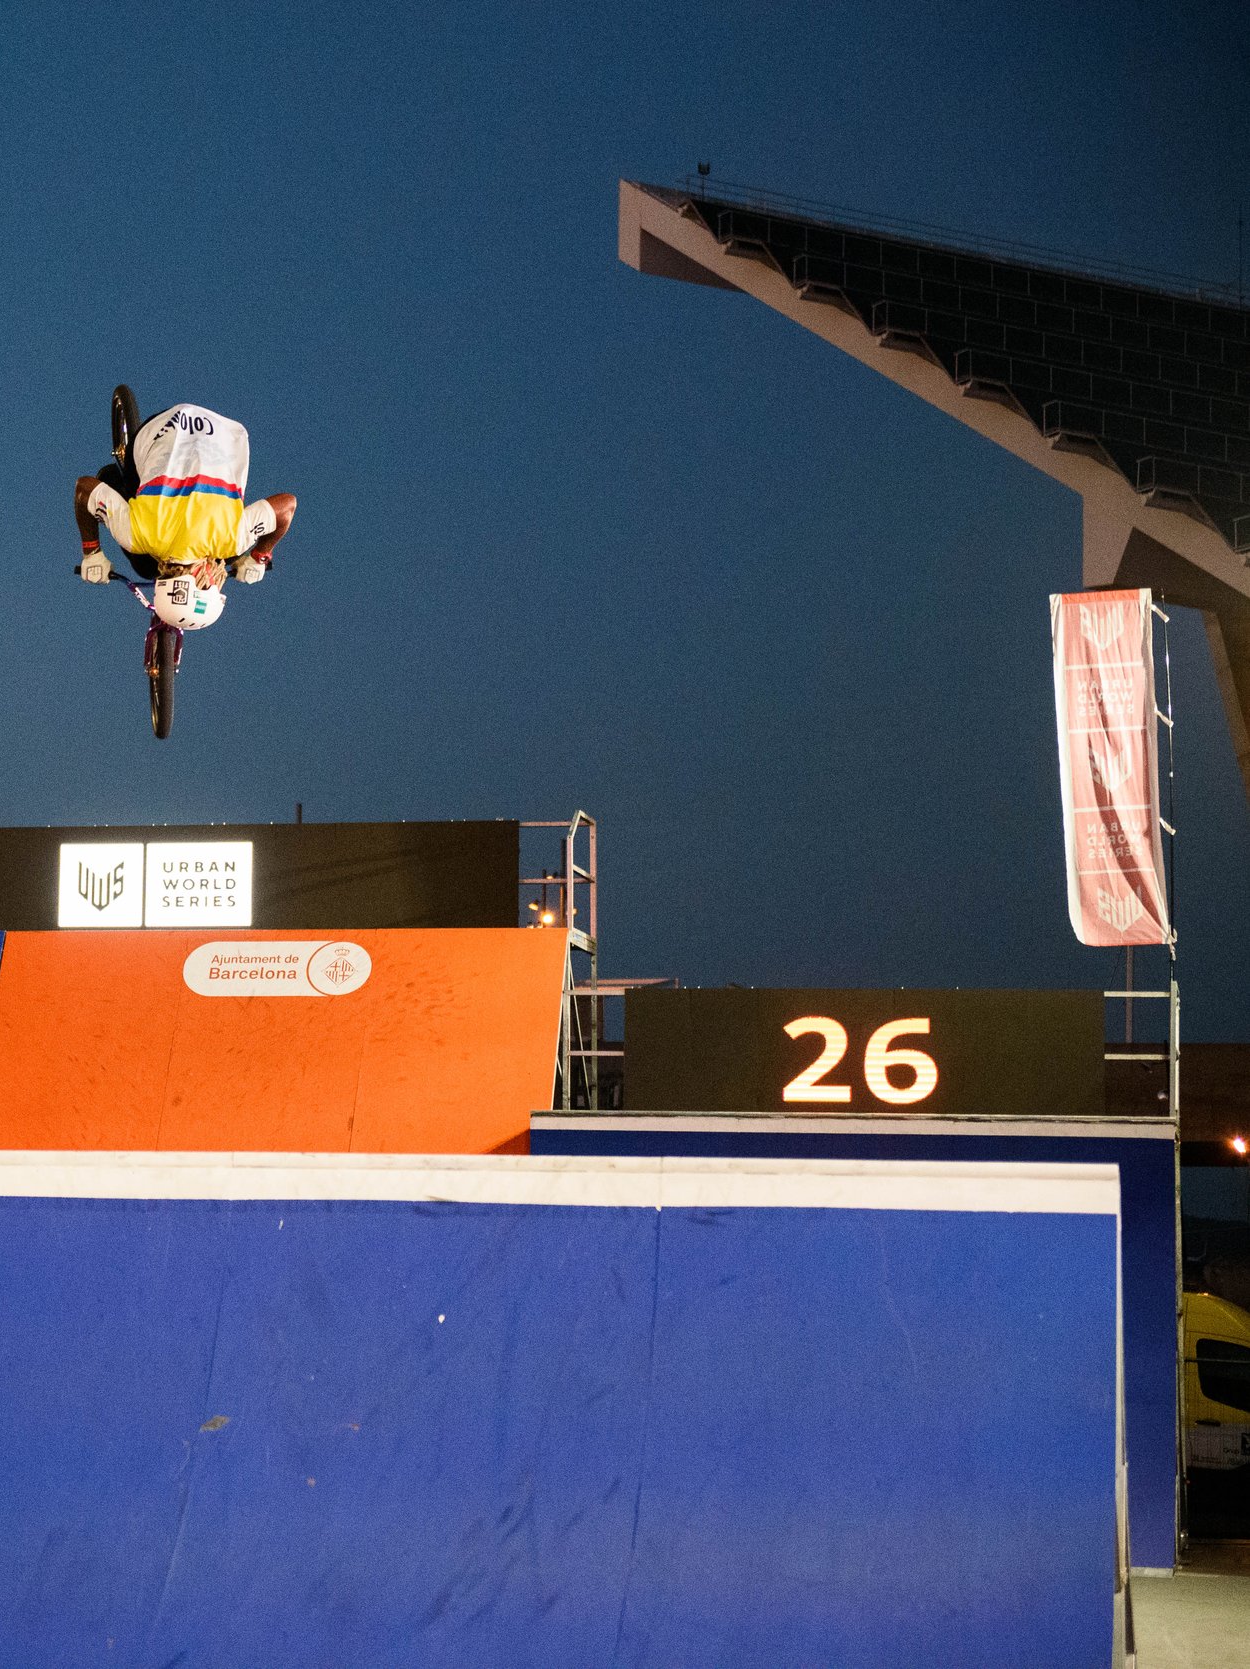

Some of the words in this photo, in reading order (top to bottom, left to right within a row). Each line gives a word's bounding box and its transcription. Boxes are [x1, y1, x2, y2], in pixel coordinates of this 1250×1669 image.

[162, 861, 236, 873] URBAN
[162, 878, 236, 890] WORLD
[162, 896, 236, 907] SERIES
[211, 954, 282, 966] Ajuntament
[284, 954, 299, 964] de
[208, 966, 297, 980] Barcelona
[783, 1015, 938, 1105] 26
